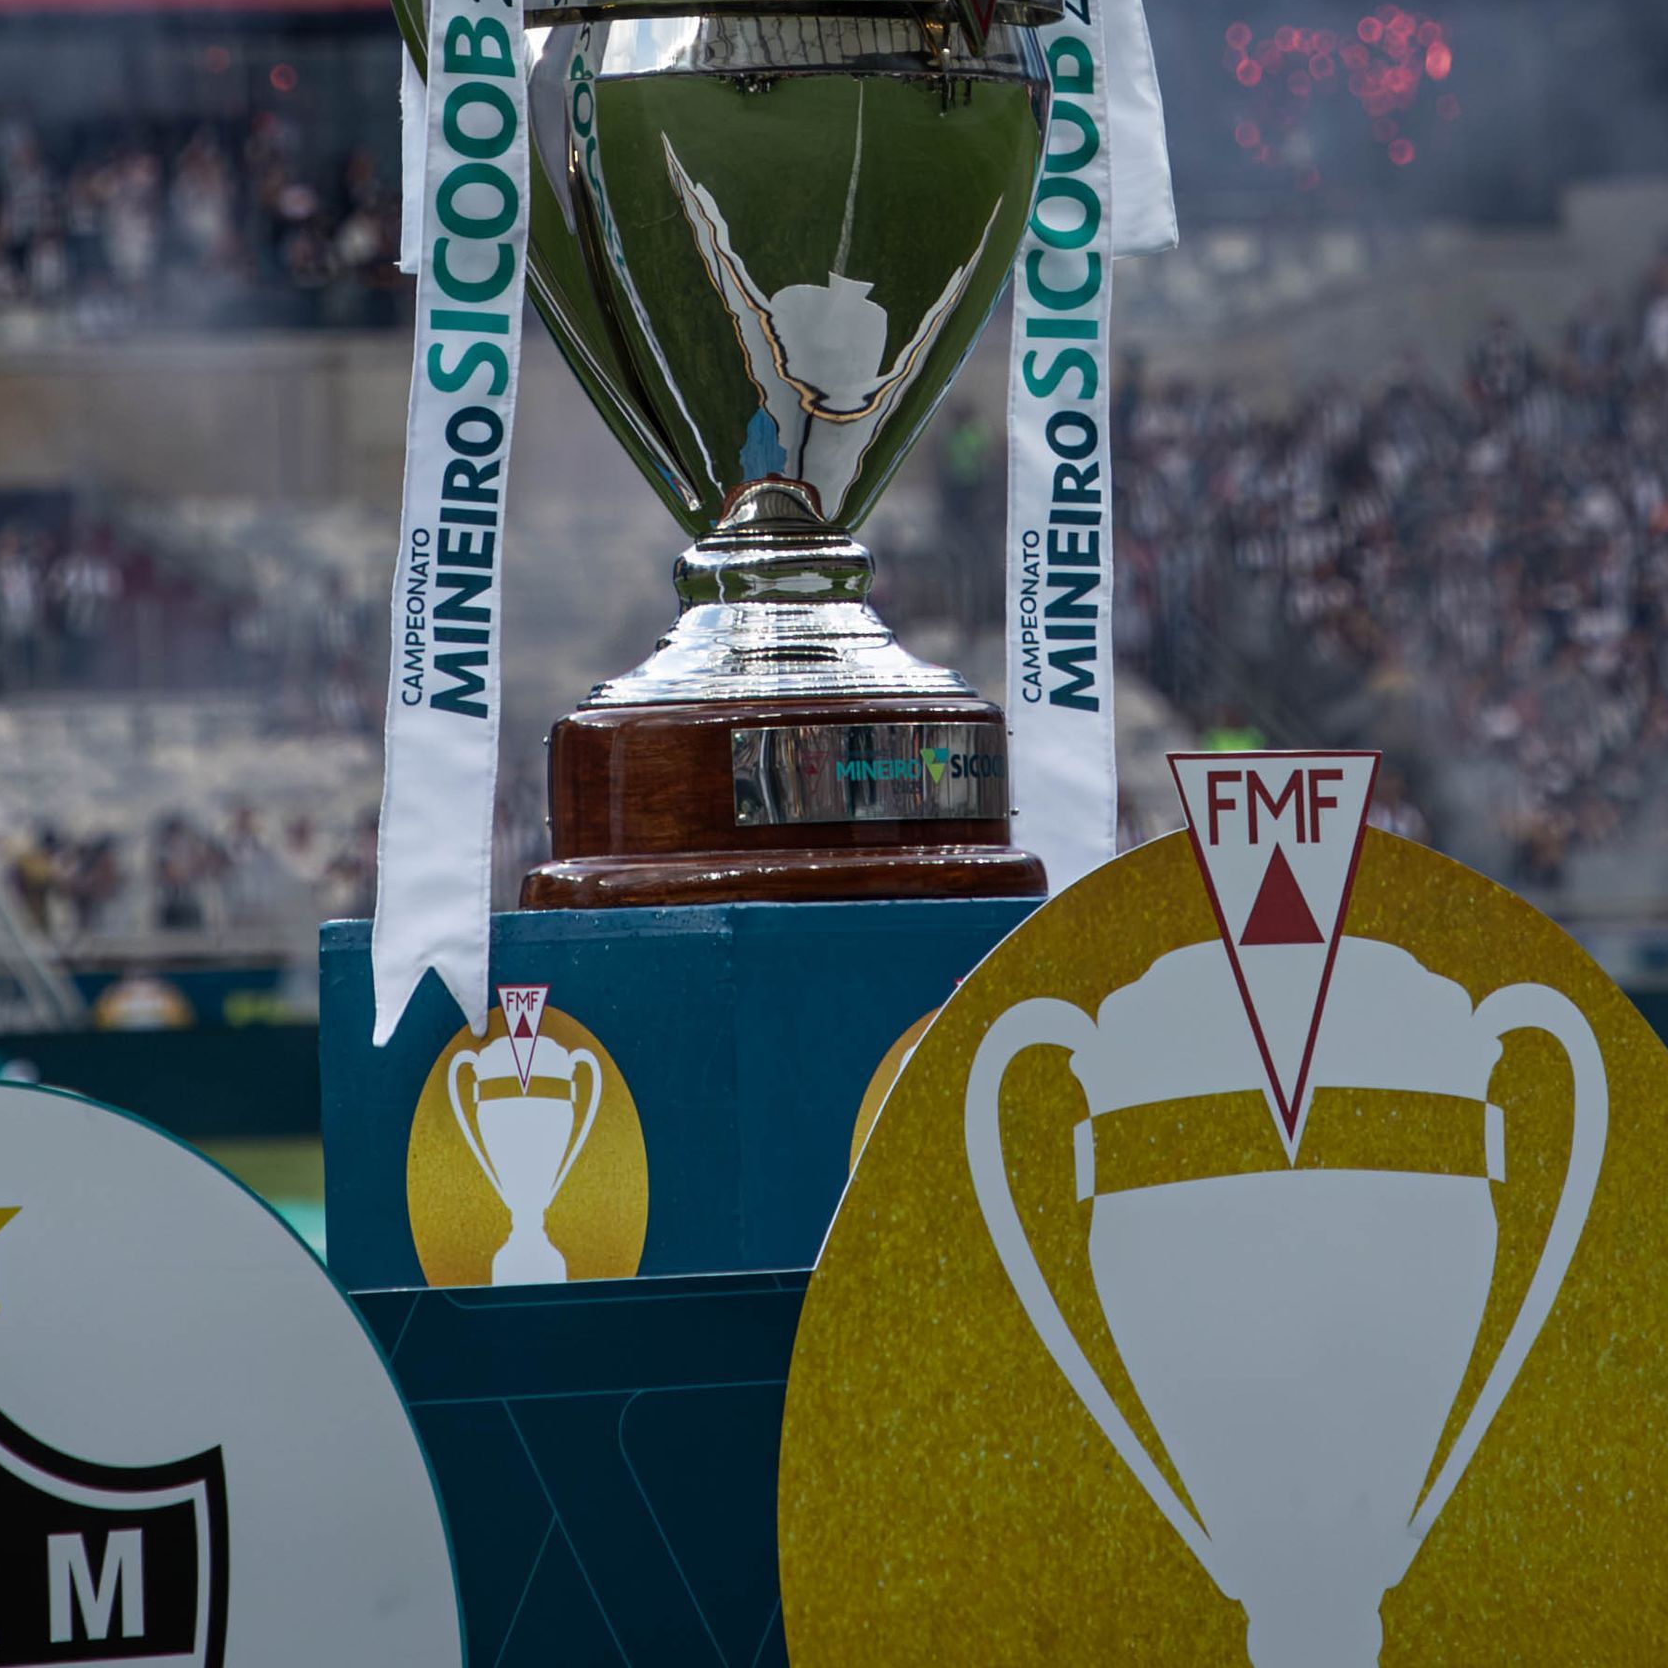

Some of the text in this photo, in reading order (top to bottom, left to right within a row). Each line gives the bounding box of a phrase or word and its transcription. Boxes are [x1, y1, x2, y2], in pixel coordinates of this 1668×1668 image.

[427, 14, 519, 397] SICOOB
[401, 527, 431, 707] CAMPEONATO
[429, 405, 504, 720] MINEIRO
[1022, 529, 1041, 704] CAMPEONATO
[1044, 410, 1102, 713] MINEIRO
[836, 759, 922, 781] MINEIRO
[1206, 768, 1344, 846] FMF
[506, 990, 540, 1012] FMF
